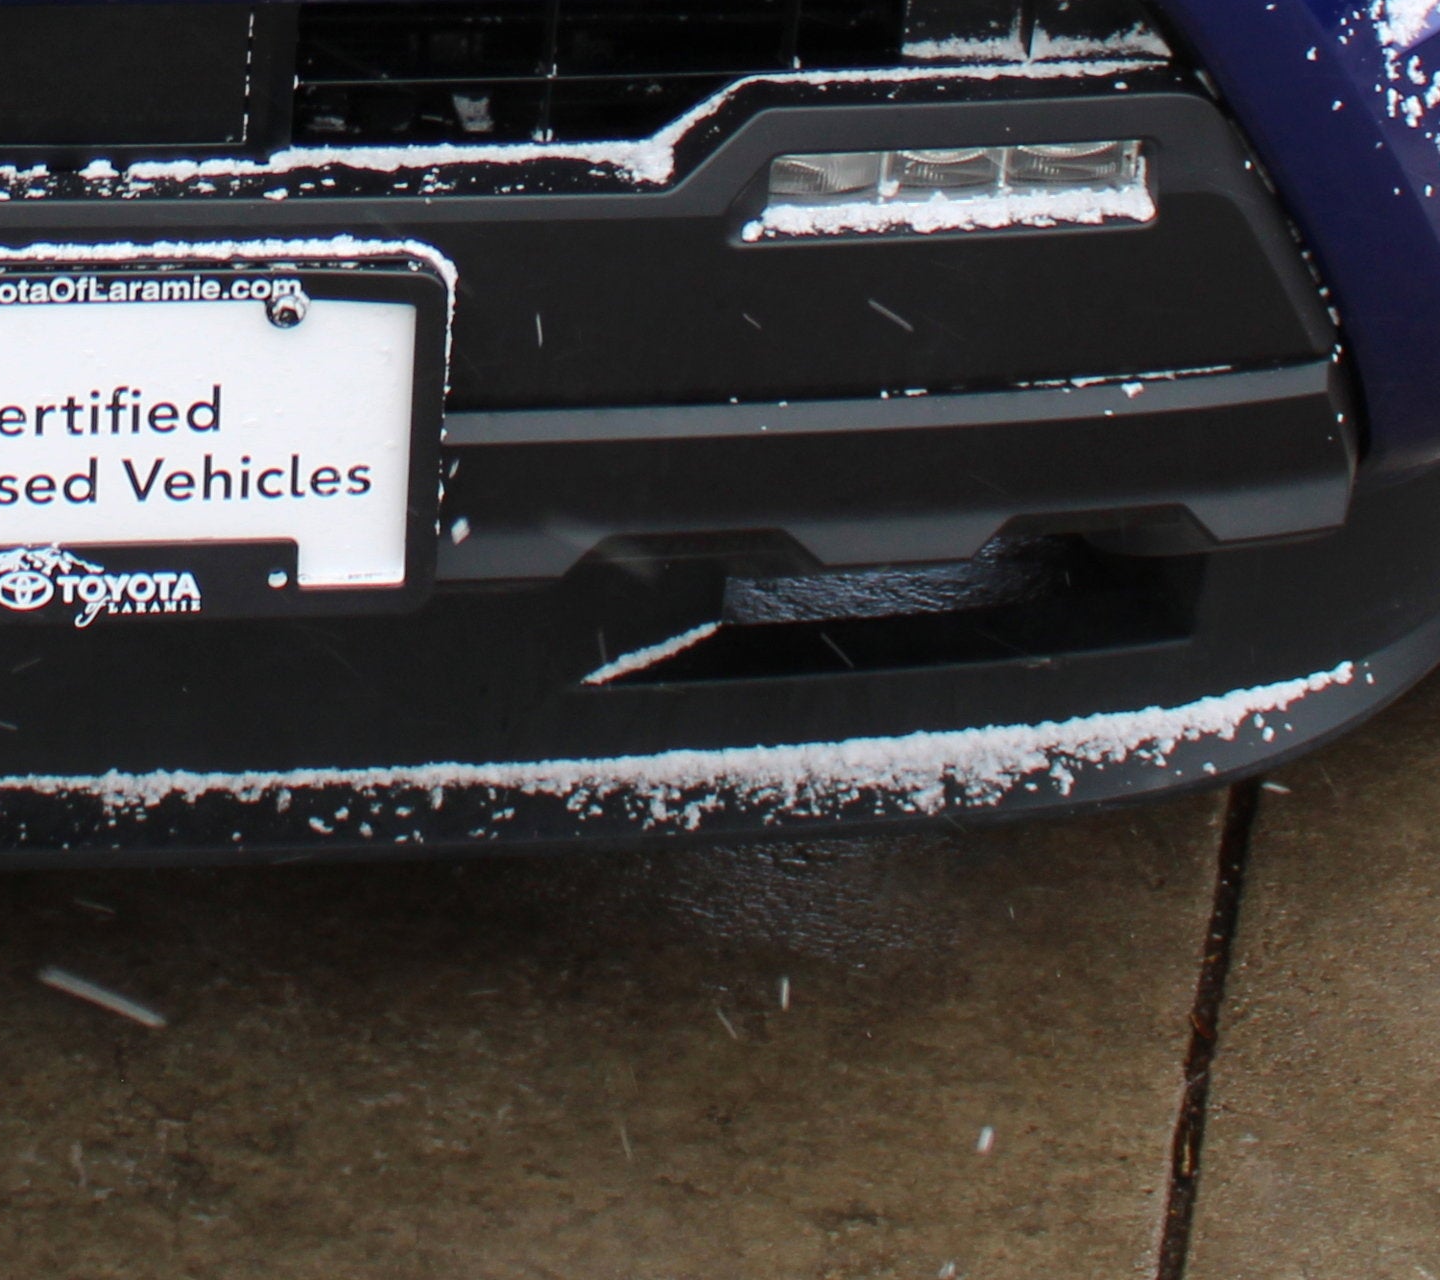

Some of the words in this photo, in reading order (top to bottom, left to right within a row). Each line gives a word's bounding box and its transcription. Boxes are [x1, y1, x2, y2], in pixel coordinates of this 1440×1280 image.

[122, 453, 372, 503] Vehicles
[56, 572, 202, 603] TOYOTA
[74, 595, 110, 628] of
[107, 599, 202, 614] LARAMIE
